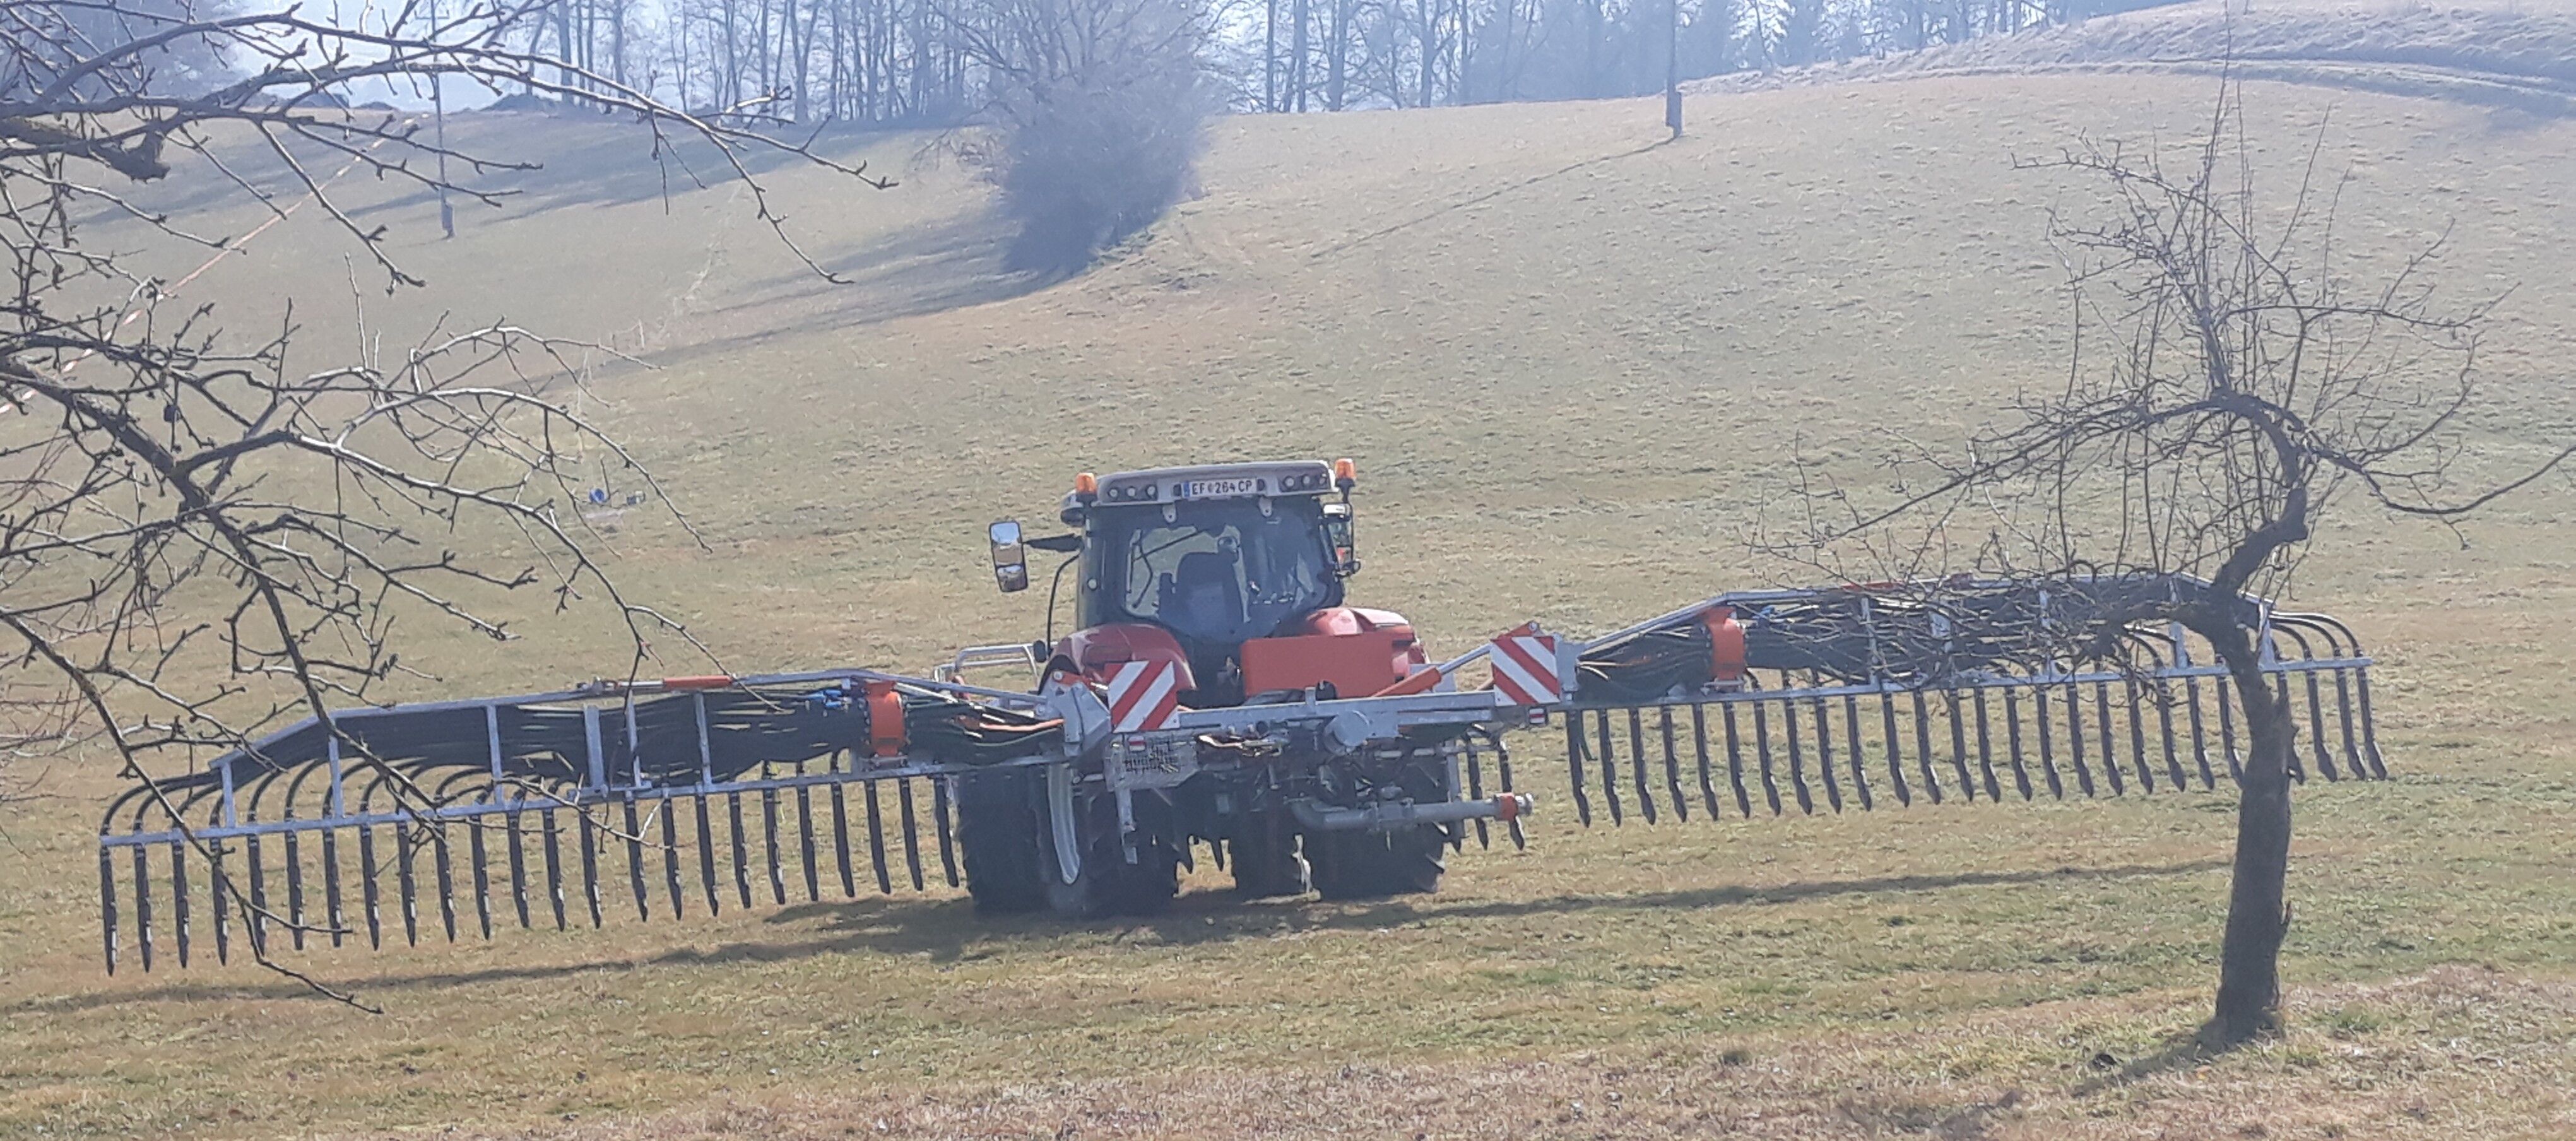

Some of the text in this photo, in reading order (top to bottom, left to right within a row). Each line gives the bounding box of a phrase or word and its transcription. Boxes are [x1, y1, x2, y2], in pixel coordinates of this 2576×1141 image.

[1191, 480, 1252, 495] EF 264 CP
